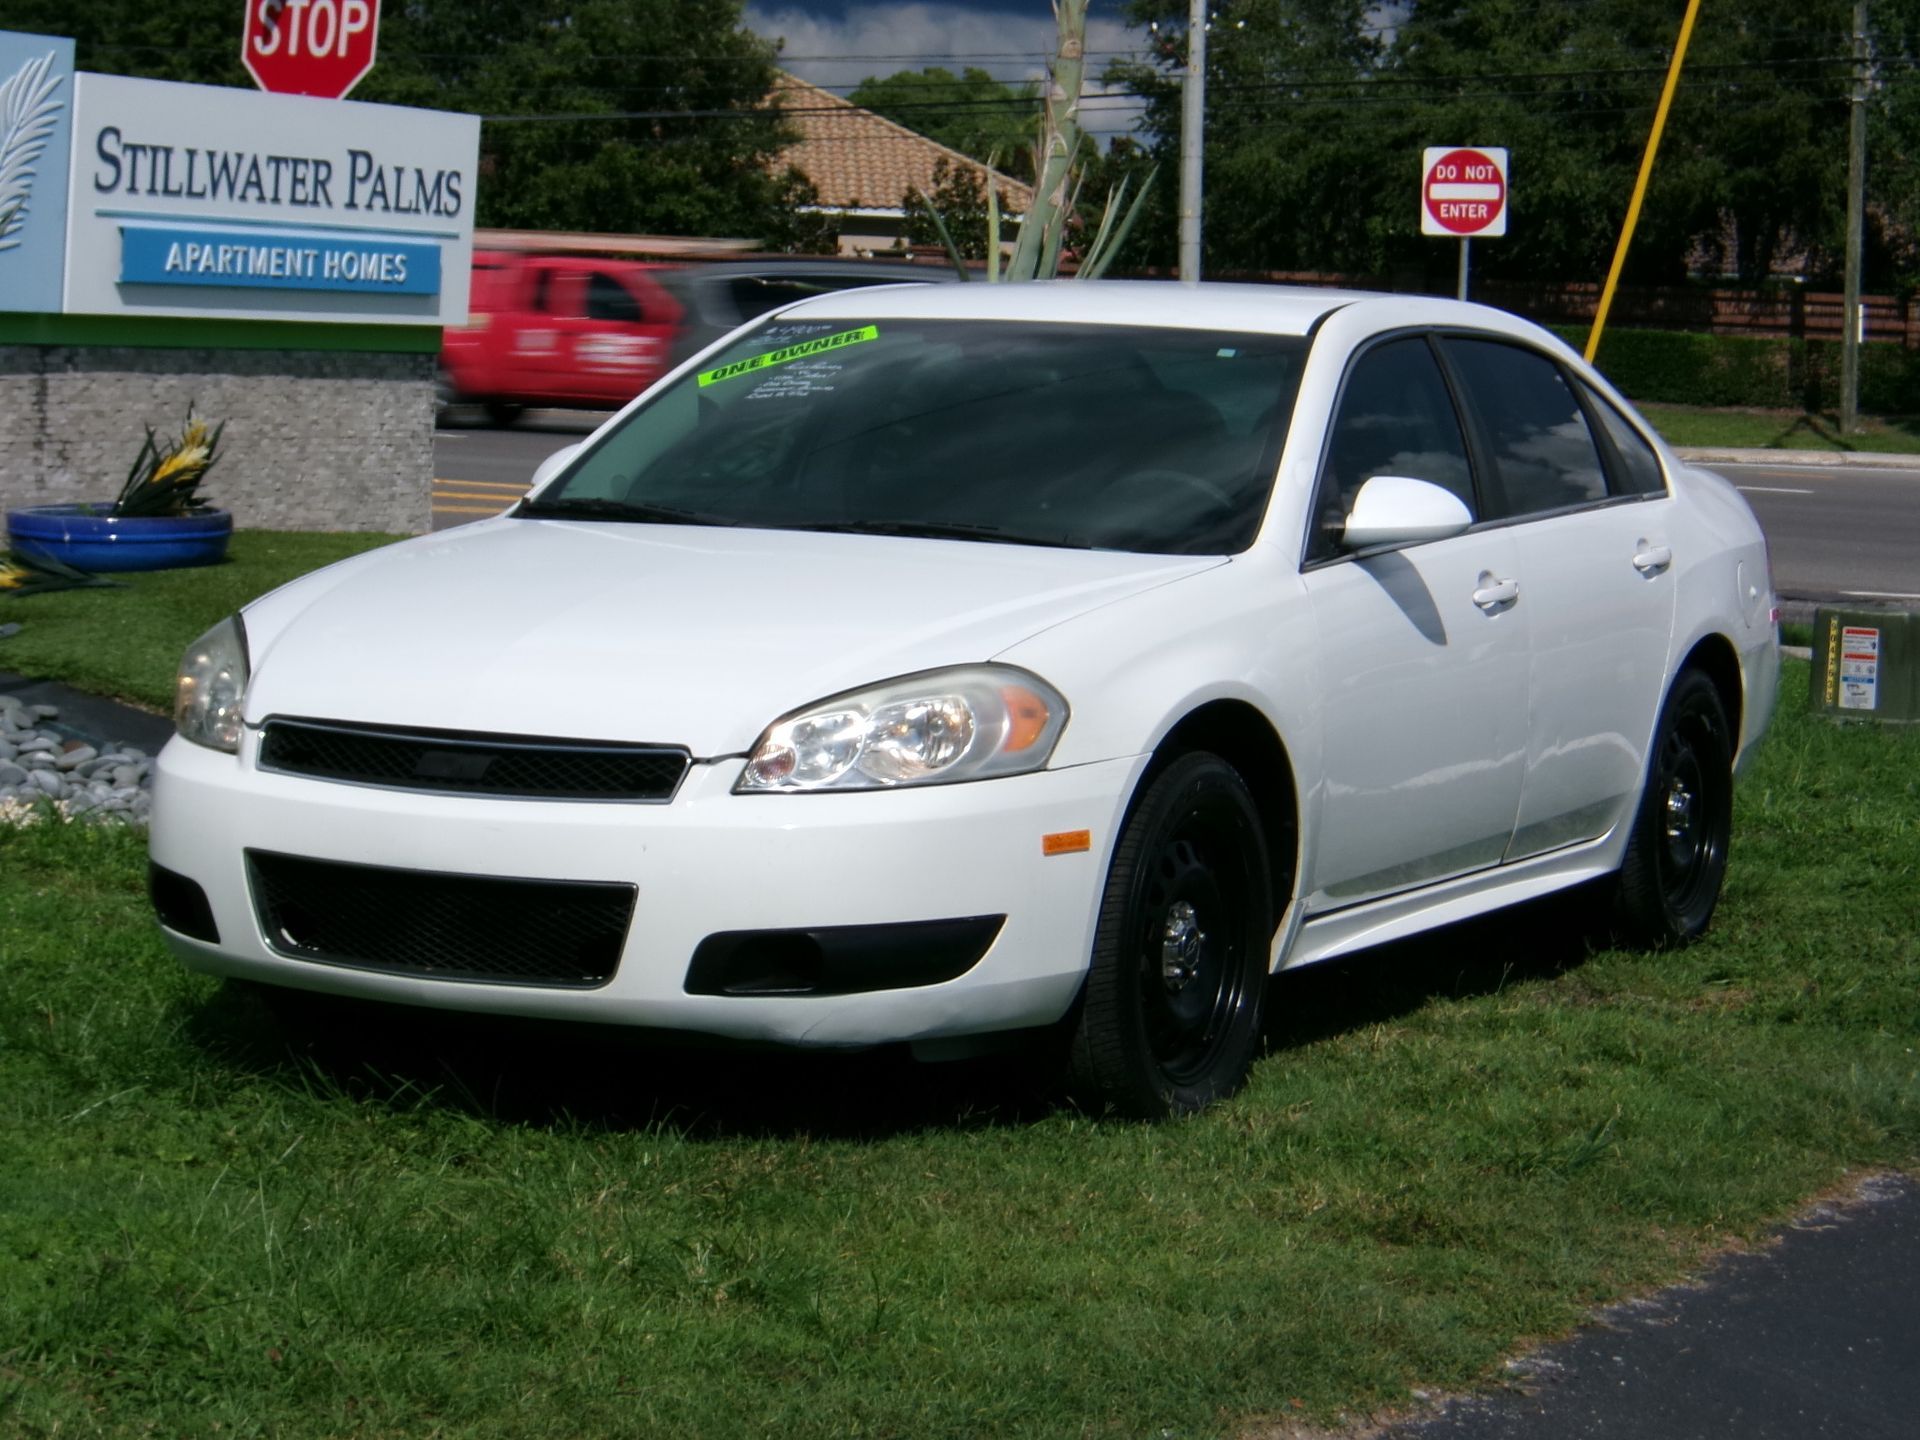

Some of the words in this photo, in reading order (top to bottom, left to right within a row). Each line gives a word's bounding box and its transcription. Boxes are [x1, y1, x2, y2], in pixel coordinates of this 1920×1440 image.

[253, 0, 369, 58] STOP
[95, 126, 334, 208] STILLWATER
[344, 149, 463, 218] PALMS
[1436, 165, 1457, 180] DO
[1465, 165, 1494, 180] NOT
[1440, 203, 1488, 219] ENTER
[165, 242, 319, 280] APARTMENT
[323, 251, 408, 283] HOMES
[711, 356, 765, 381] ONE
[770, 331, 865, 362] OWNER
